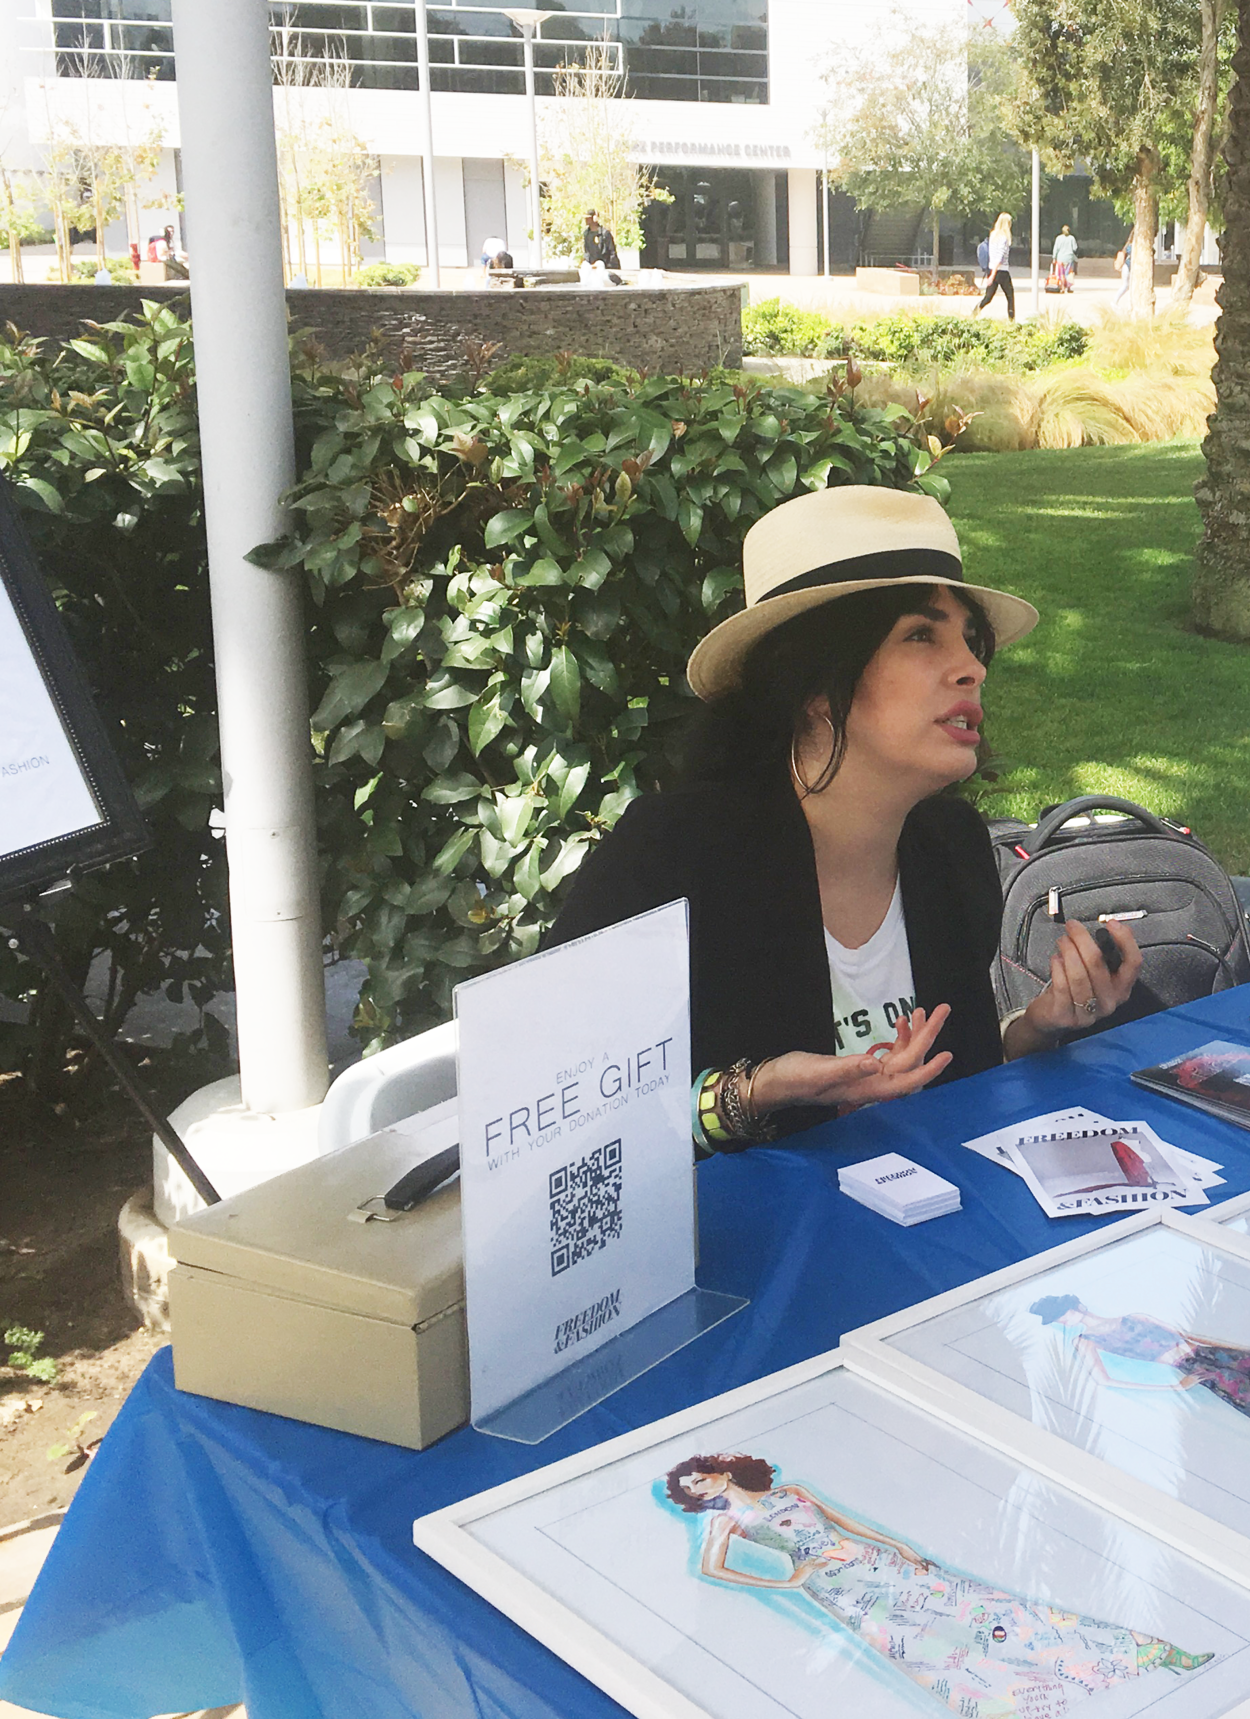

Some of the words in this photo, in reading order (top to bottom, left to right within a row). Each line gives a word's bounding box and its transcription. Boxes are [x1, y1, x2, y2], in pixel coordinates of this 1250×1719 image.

[651, 141, 741, 156] PERFORMANCE
[744, 144, 792, 158] CENTER
[556, 1056, 595, 1084] ENJOY
[602, 1051, 610, 1063] A
[485, 1081, 581, 1157] FREE
[599, 1037, 673, 1098] GIFT
[487, 1146, 520, 1171] WITH
[527, 1125, 562, 1151] YOUR
[569, 1093, 629, 1132] DONATION
[634, 1073, 670, 1098] TODAY
[1018, 1127, 1138, 1146] FREEDOM
[1056, 1188, 1187, 1211] &FASHION
[554, 1288, 620, 1341] FREEDOM
[554, 1301, 622, 1355] &FASHION
